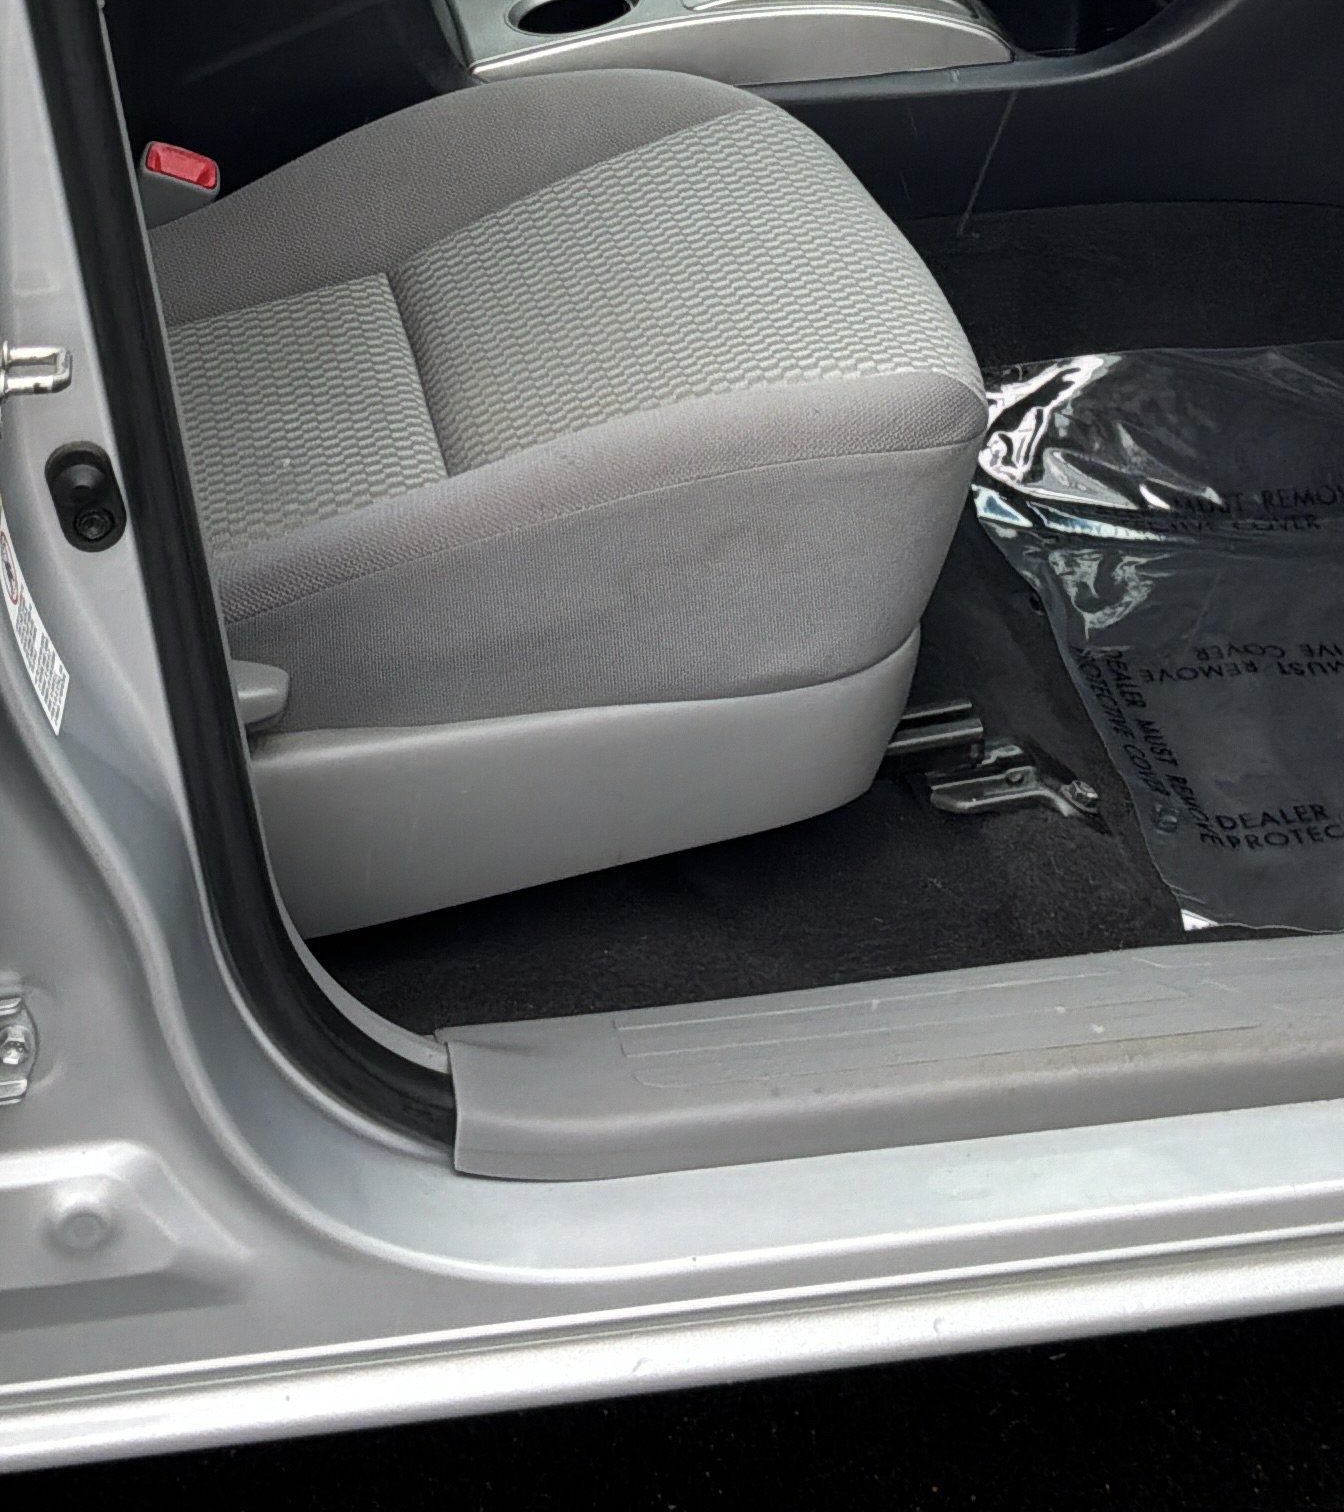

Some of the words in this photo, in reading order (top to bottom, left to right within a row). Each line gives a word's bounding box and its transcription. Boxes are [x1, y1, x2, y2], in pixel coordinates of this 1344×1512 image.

[1196, 642, 1286, 662] COVER
[1139, 660, 1259, 686] REMOVE
[1133, 718, 1178, 767] MUST
[1215, 803, 1329, 831] DEALER
